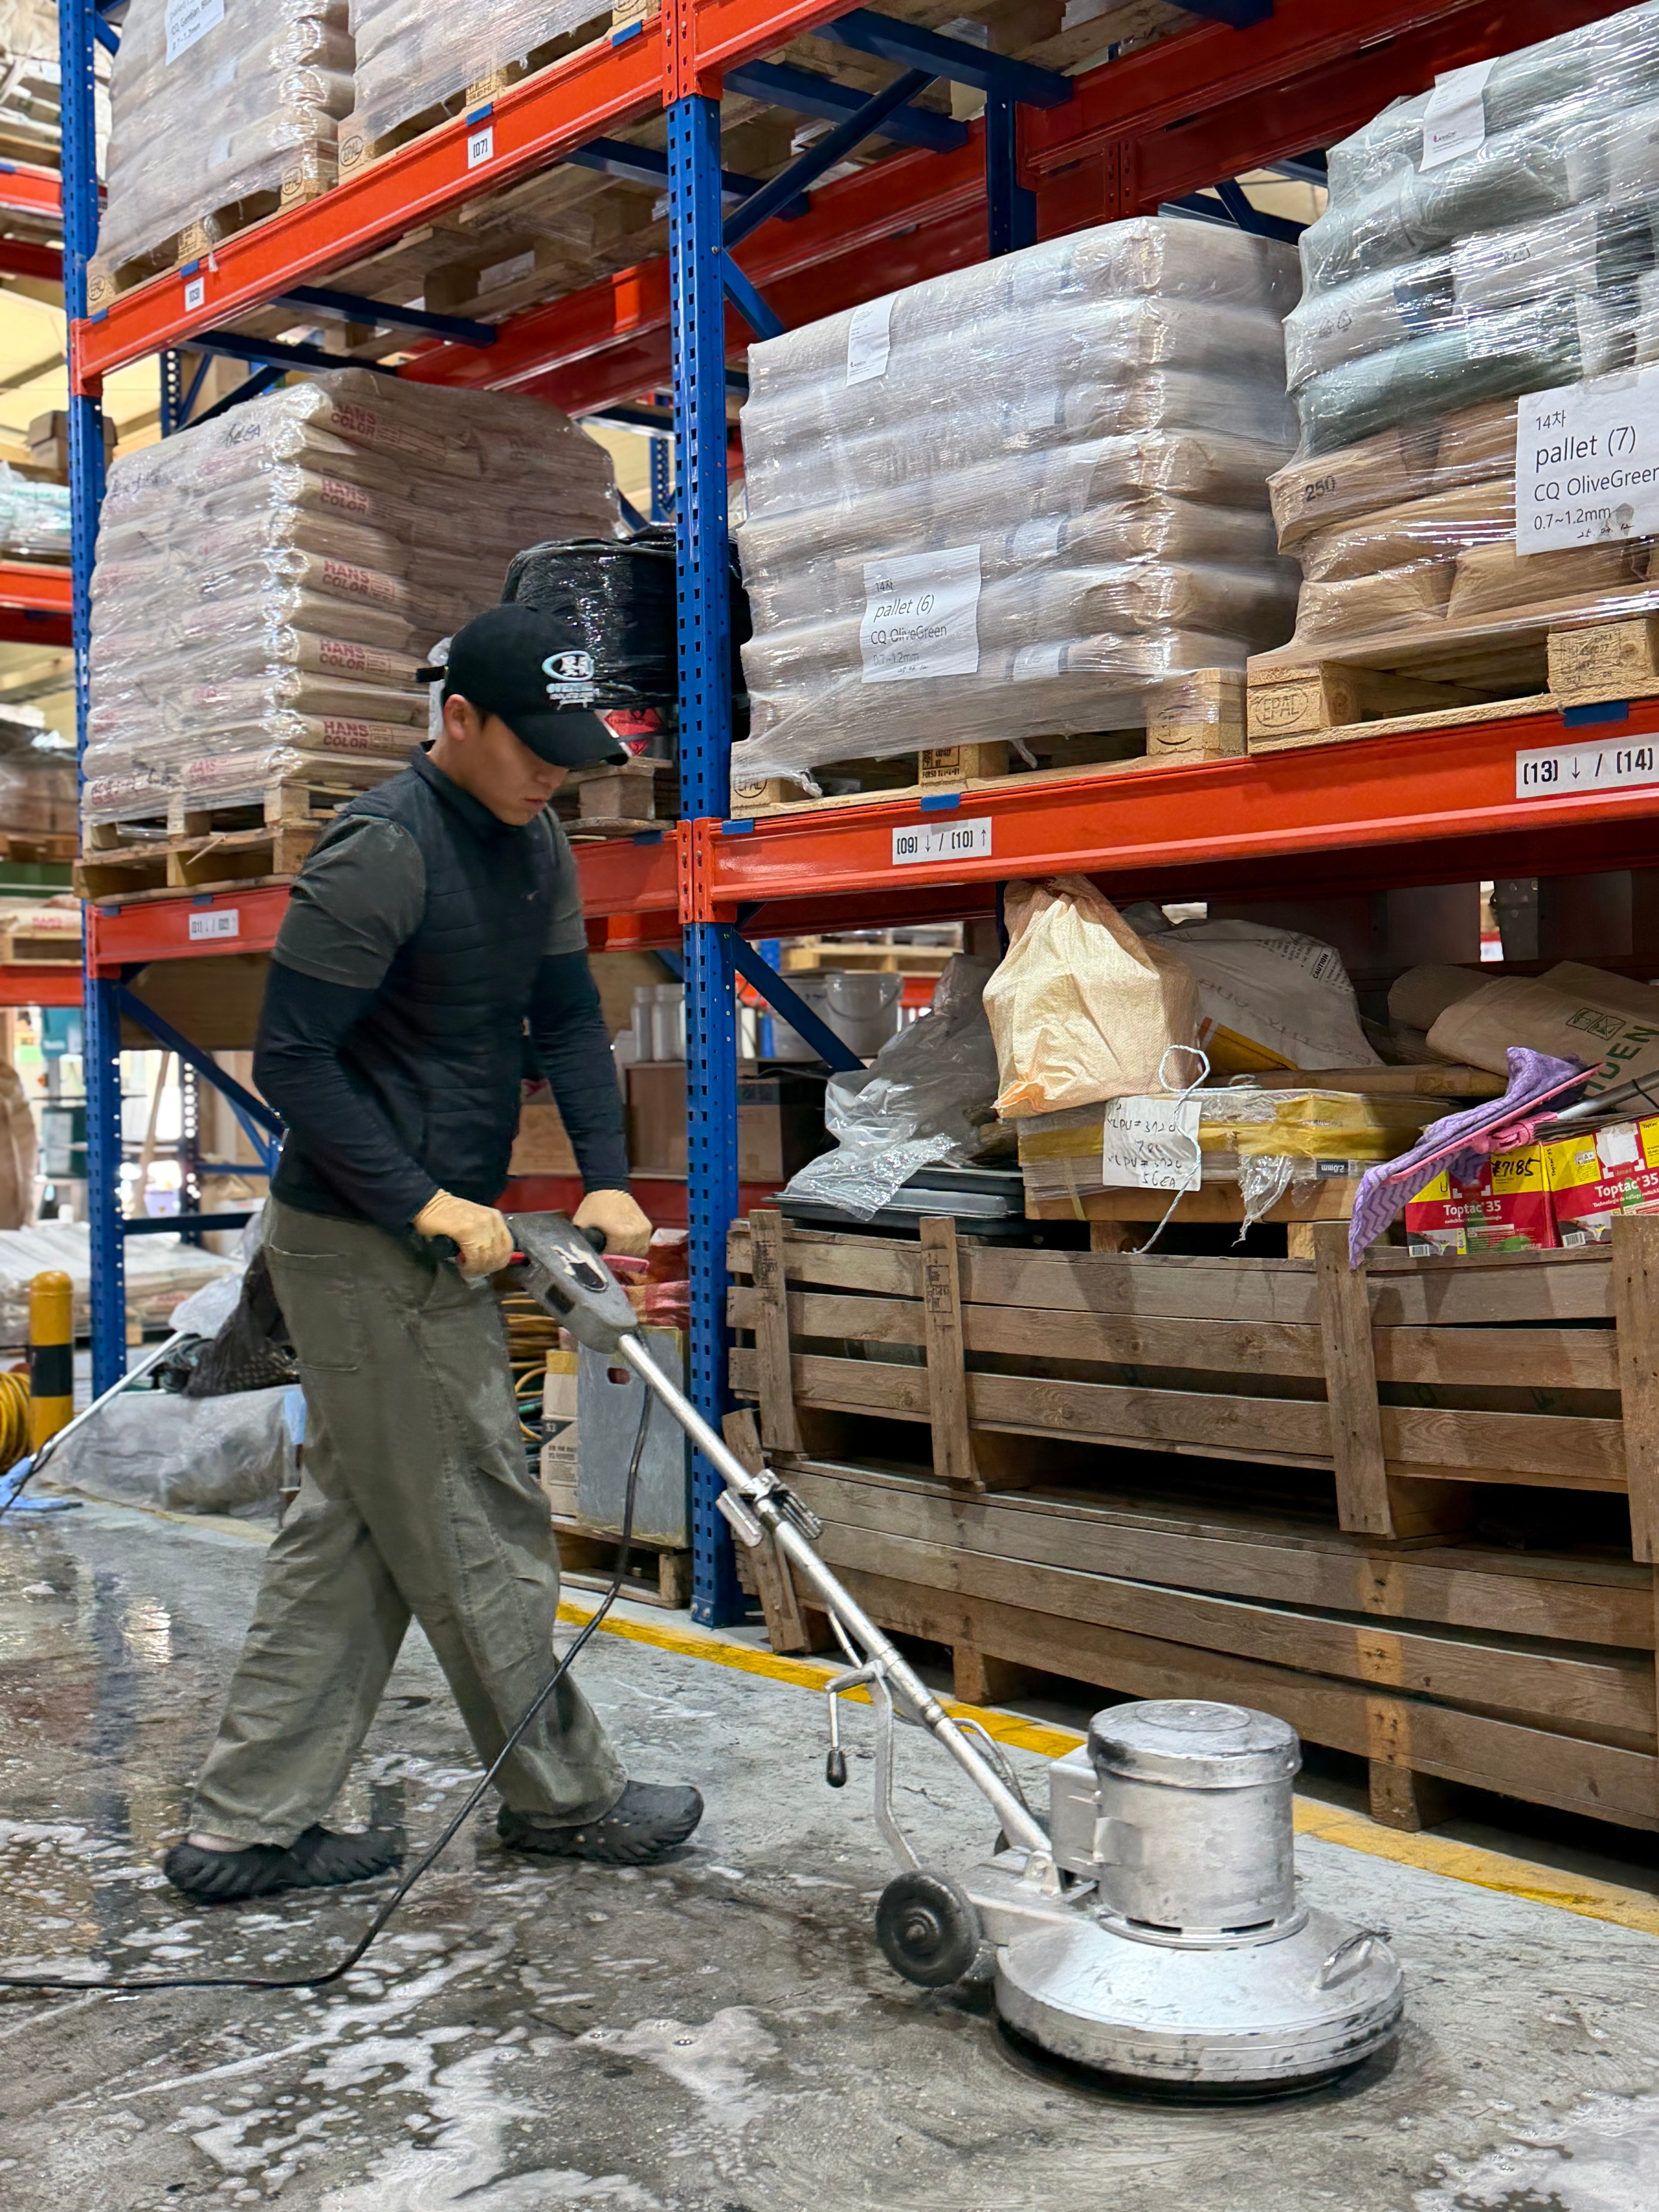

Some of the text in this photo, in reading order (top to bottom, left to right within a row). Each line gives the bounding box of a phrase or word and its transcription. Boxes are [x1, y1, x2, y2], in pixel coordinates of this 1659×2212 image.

[331, 413, 375, 436] COLOR
[1535, 409, 1567, 431] 14차
[1535, 426, 1636, 474] pallet (7)
[1305, 476, 1335, 502] 250
[1534, 482, 1560, 502] CQ
[320, 493, 366, 513] COLOR
[1534, 507, 1611, 530] 0.7~1.2mm
[324, 560, 370, 584] HANS
[322, 574, 369, 595] COLOR
[873, 594, 934, 623] pallet (6)
[871, 625, 947, 645] CQ OliveGreen
[320, 639, 365, 659] HANS
[319, 652, 365, 671] COLOR
[1263, 693, 1300, 721] EPAL
[323, 721, 369, 737] HANS
[323, 735, 368, 749] COLOR
[1523, 760, 1558, 785] (13)
[1617, 747, 1653, 774] (14)
[897, 836, 918, 855] (09)
[952, 830, 973, 849] (10)
[1313, 953, 1329, 979] CAUTION
[1141, 1170, 1176, 1188] 56EA
[1321, 1164, 1344, 1173] 2.0mm
[1594, 1172, 1659, 1199] Toptac 35
[1443, 1200, 1501, 1218] Toptac 35
